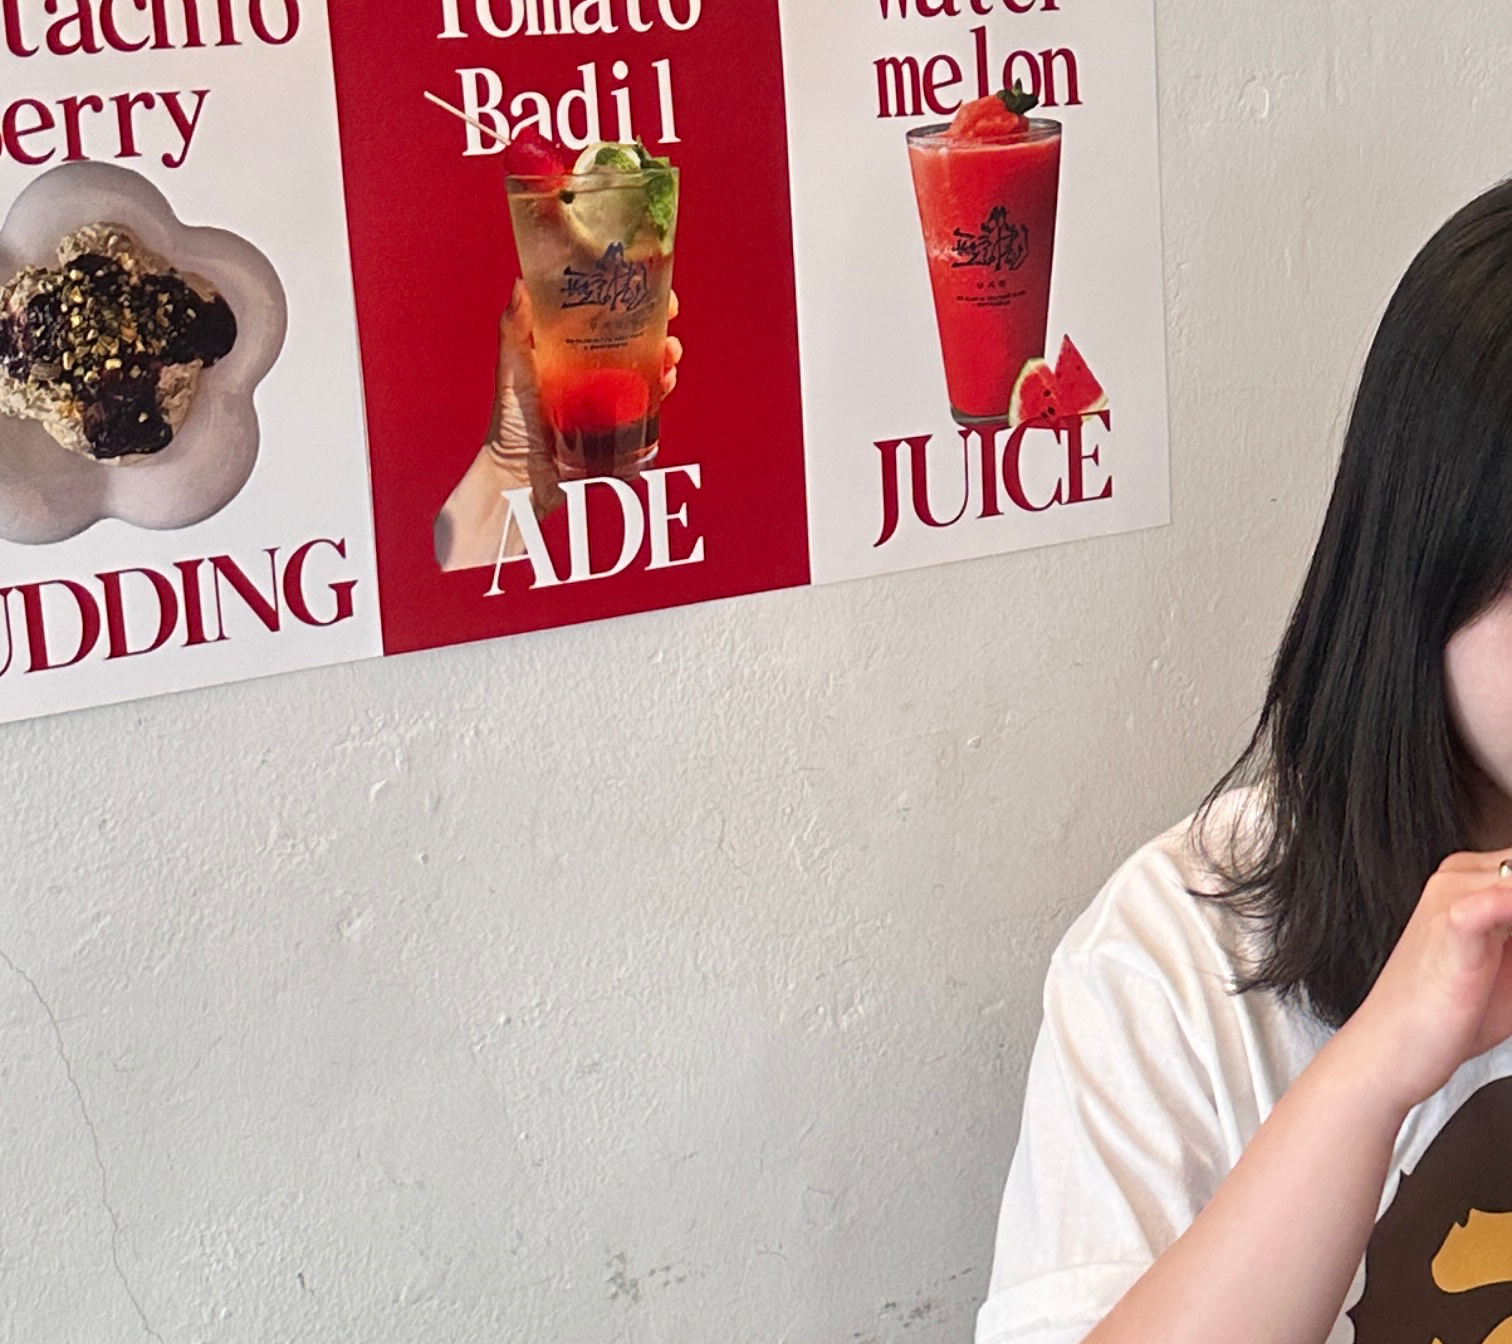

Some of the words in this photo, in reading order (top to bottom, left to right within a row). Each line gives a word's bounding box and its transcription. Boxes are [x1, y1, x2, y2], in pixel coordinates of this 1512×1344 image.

[454, 58, 682, 157] Badil
[873, 25, 1084, 118] melon
[0, 89, 211, 169] erry
[872, 408, 1113, 548] JUICE
[483, 463, 705, 598] ADE
